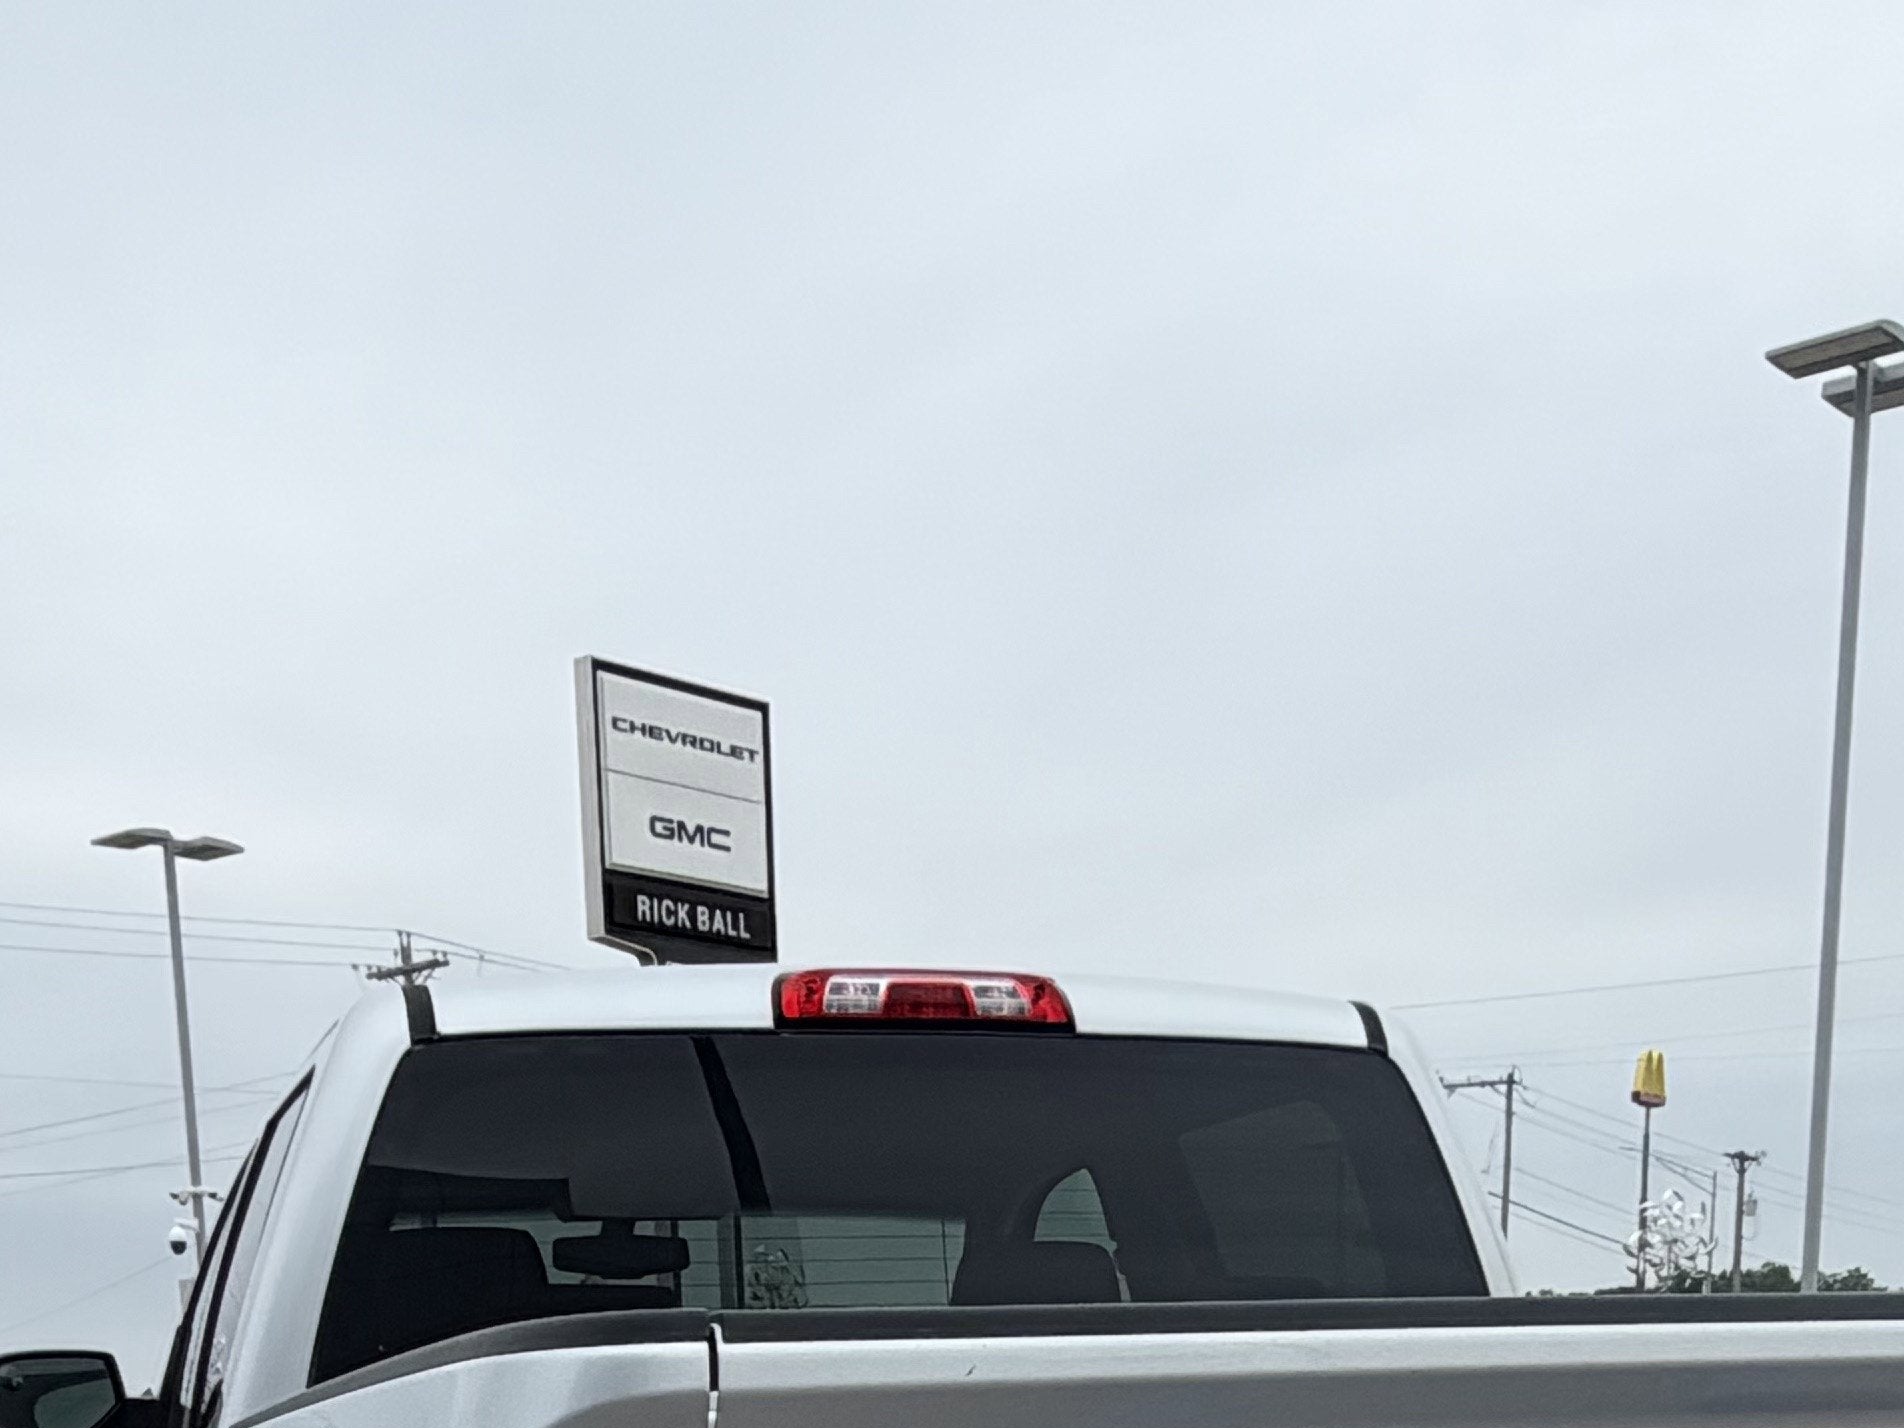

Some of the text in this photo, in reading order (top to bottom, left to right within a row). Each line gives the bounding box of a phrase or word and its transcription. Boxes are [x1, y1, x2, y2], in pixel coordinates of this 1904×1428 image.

[610, 715, 760, 764] CHEVROLET
[649, 814, 731, 853] GMC
[636, 894, 751, 939] RICK BALL
